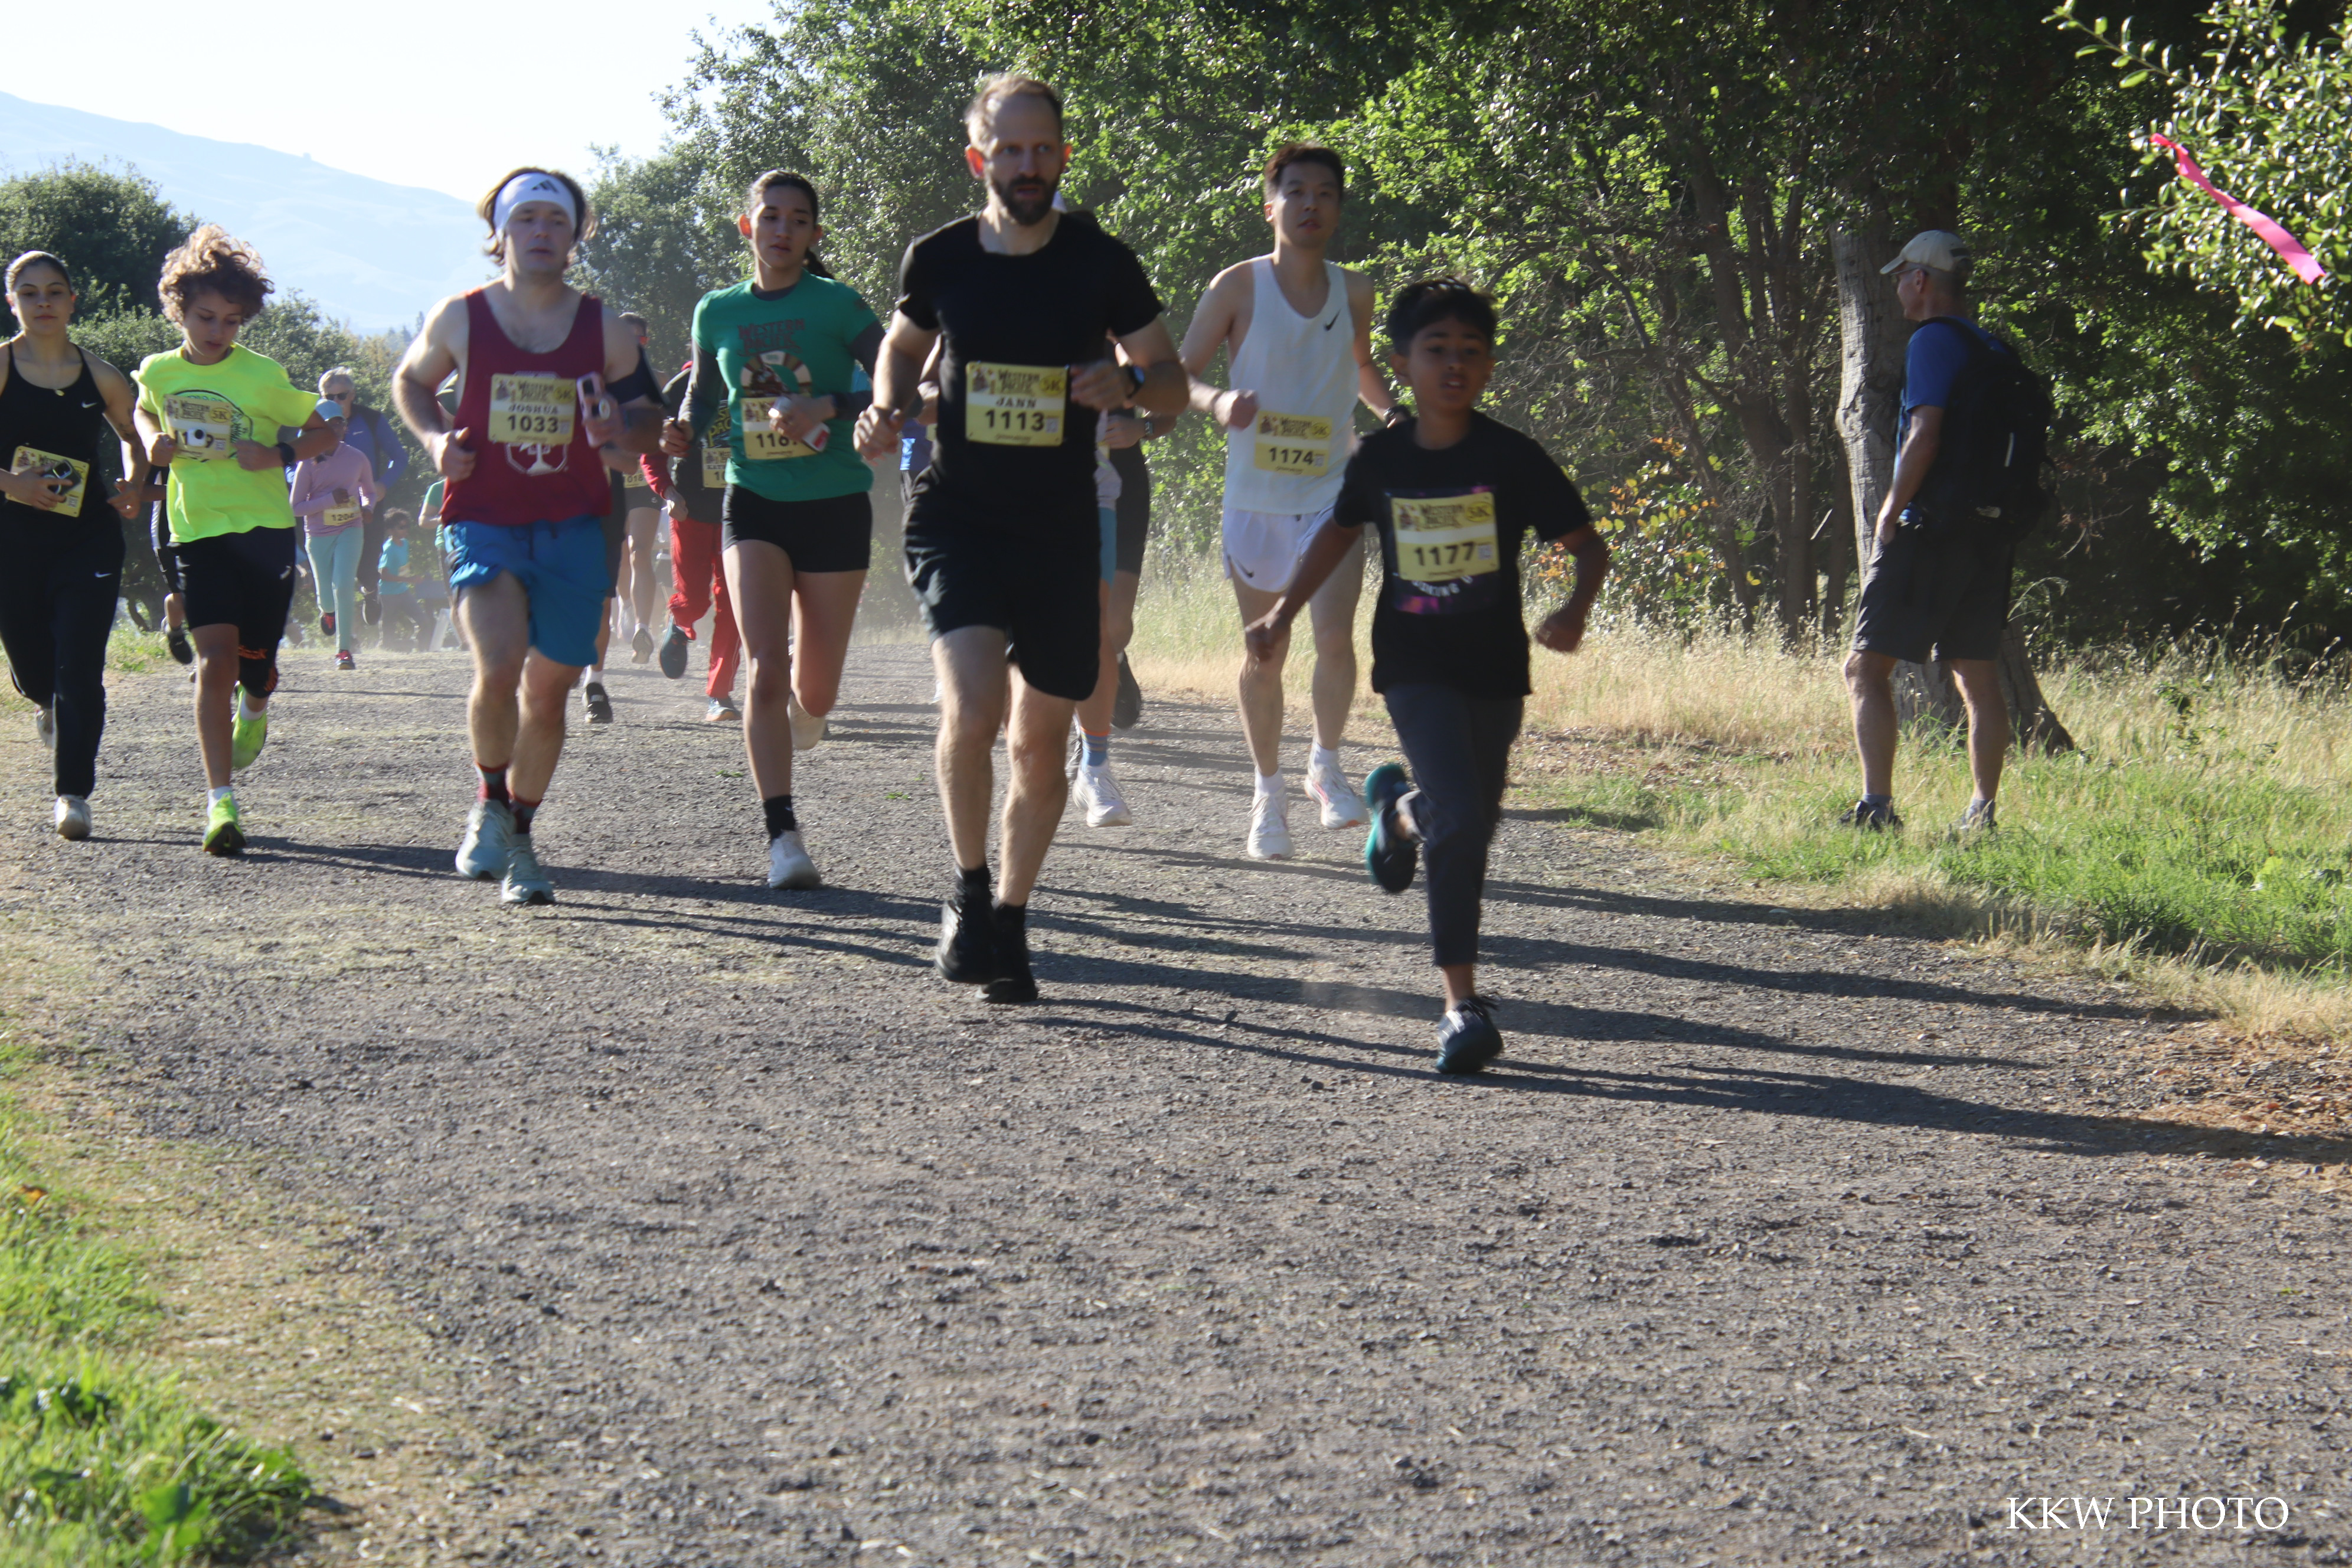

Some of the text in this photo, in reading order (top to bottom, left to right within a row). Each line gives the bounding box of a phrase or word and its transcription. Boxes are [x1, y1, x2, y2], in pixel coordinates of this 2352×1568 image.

[508, 403, 558, 414] JOSHUA
[996, 397, 1037, 409] JANN
[212, 409, 227, 420] 5K
[985, 409, 1044, 432] 1113
[507, 414, 558, 433] 1033
[756, 433, 798, 448] 116
[1269, 447, 1314, 465] 1174
[1414, 541, 1475, 566] 1177
